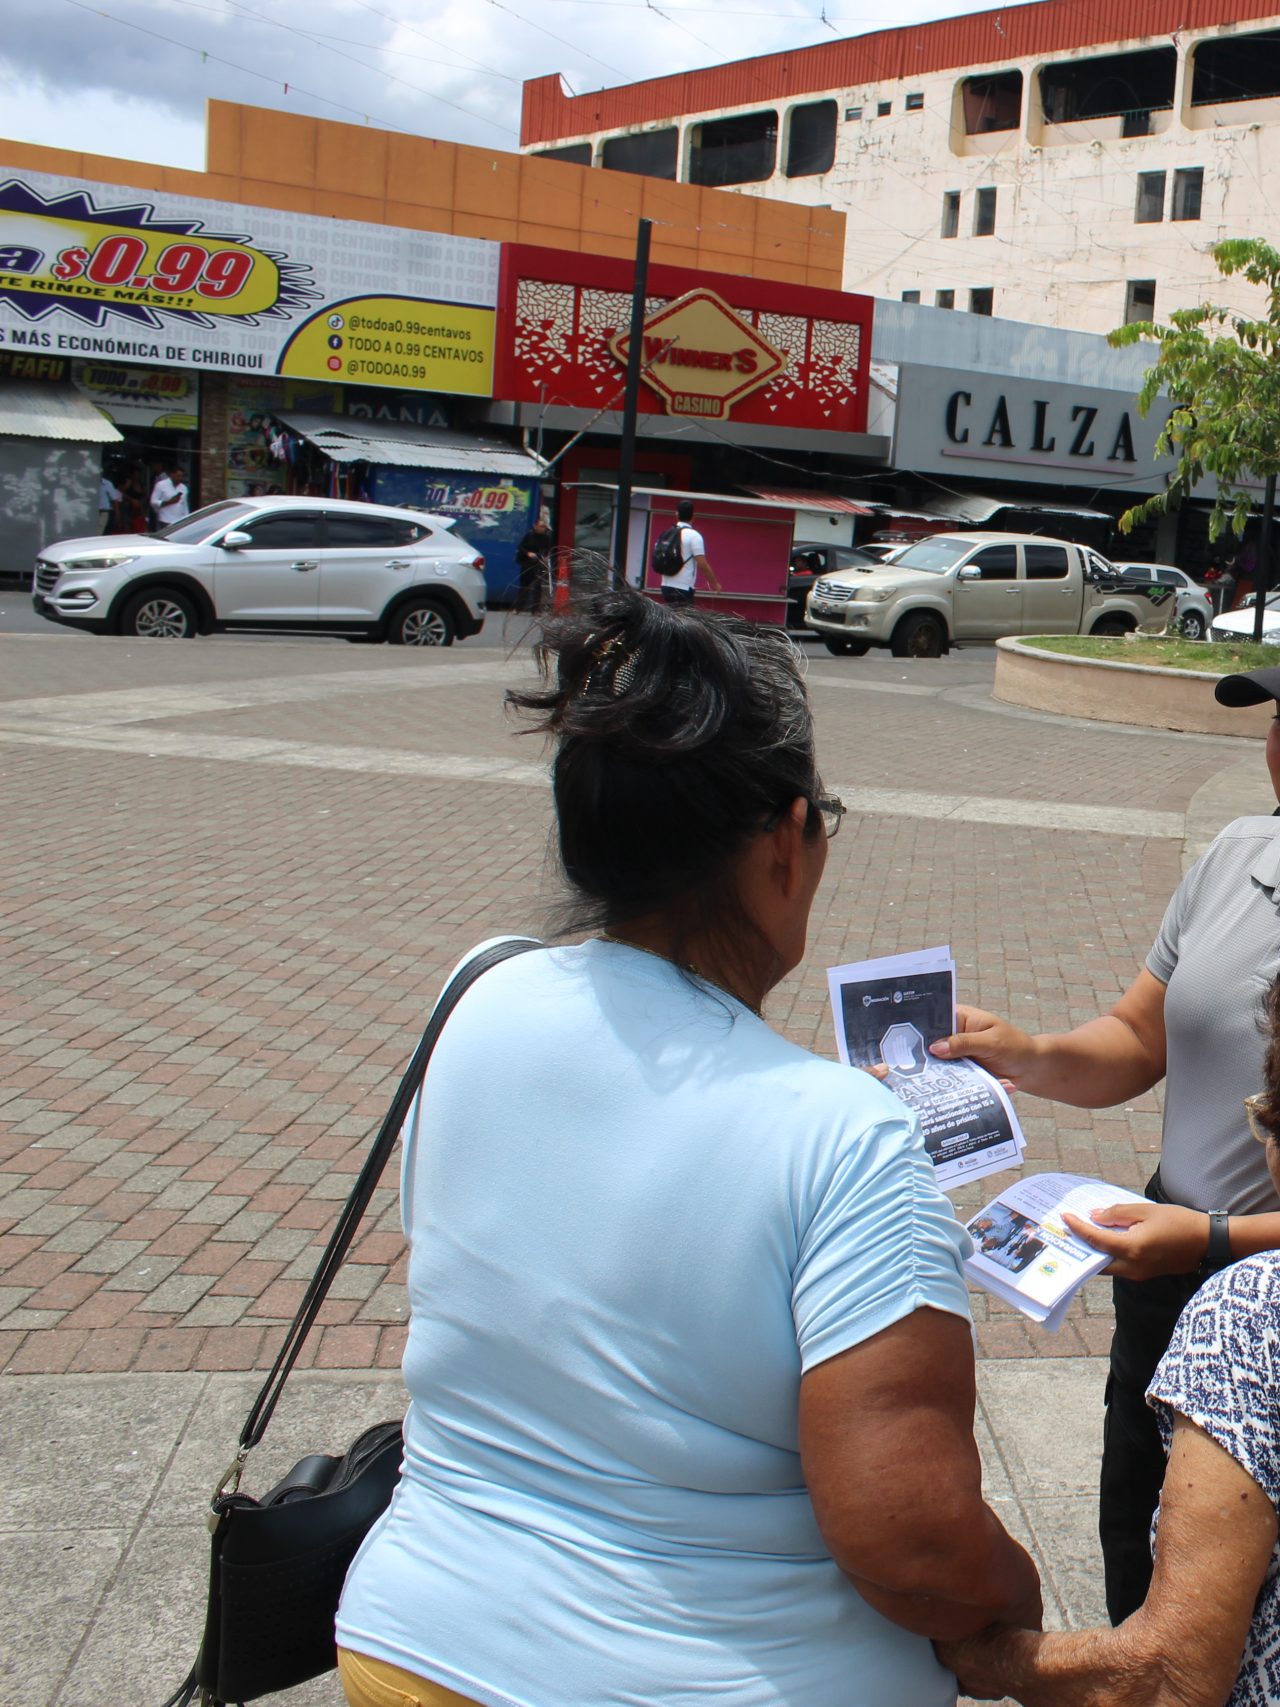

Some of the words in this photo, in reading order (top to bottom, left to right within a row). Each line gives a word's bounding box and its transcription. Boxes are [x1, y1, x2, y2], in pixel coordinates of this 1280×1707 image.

[51, 234, 255, 299] $0.99
[30, 279, 107, 297] RINDE
[349, 315, 471, 340] @todoa0.99centavos
[11, 328, 52, 347] MÁS
[57, 333, 160, 358] ECONÓMICA
[165, 345, 187, 360] DE
[192, 348, 265, 369] CHIRIQUÍ
[348, 336, 381, 352] TODO
[384, 342, 392, 354] A
[395, 342, 421, 356] 0.99
[423, 345, 484, 364] CENTAVOS
[347, 360, 426, 379] @TODOA0.99
[674, 395, 721, 415] CASINO
[945, 390, 1138, 462] CALZA
